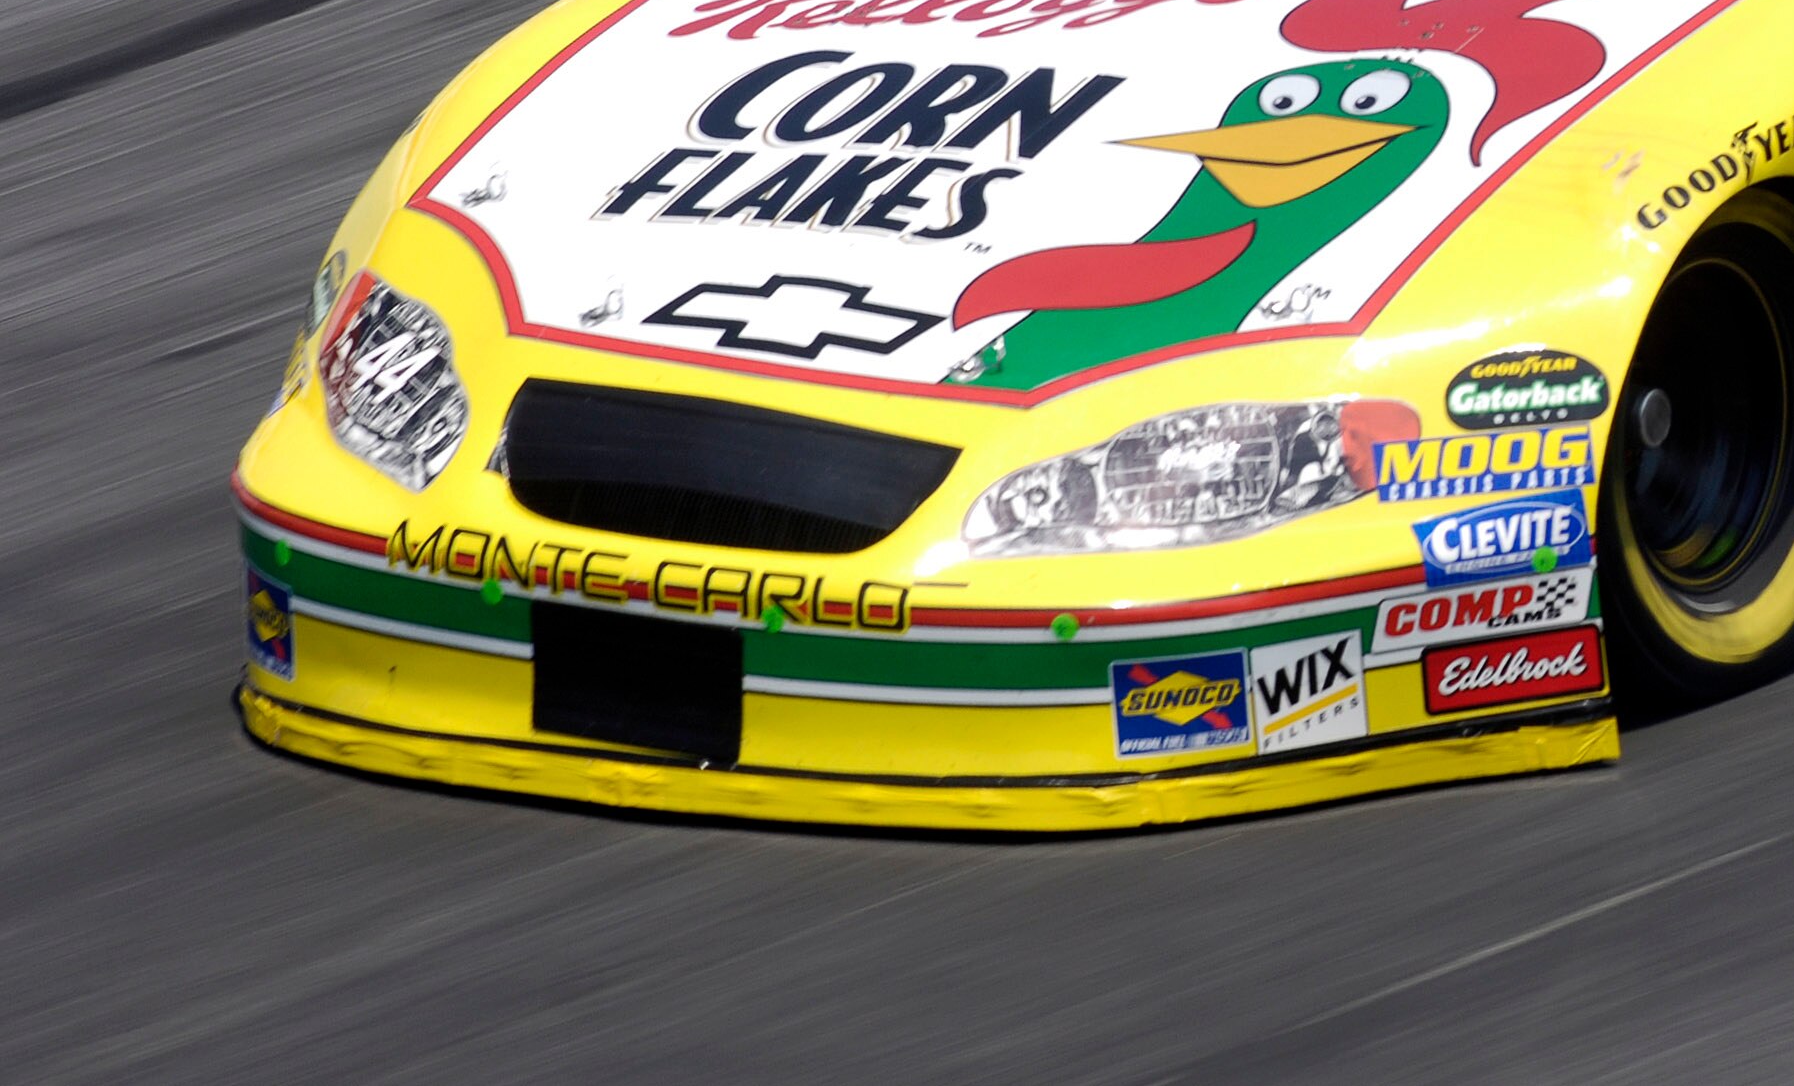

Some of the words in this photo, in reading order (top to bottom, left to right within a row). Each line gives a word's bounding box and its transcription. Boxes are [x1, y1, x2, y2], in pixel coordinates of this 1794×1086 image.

[692, 50, 1125, 159] CORN
[596, 148, 1022, 242] FLAKES
[1470, 356, 1578, 378] GOODYEAR
[1449, 375, 1602, 415] Gatorback
[1379, 425, 1590, 486] MOOG
[1388, 474, 1494, 501] CHASSIS
[1511, 465, 1588, 491] PARTS
[1430, 506, 1572, 564] CLEVITE
[389, 518, 630, 603] MONTE
[654, 560, 911, 632] CARLO
[1384, 583, 1534, 638] COMP
[1487, 606, 1562, 628] CAMS
[1257, 635, 1354, 715] WIX
[1437, 641, 1587, 696] Edelbrock
[1127, 683, 1235, 712] SUNOCO
[1263, 697, 1361, 749] FILTERS
